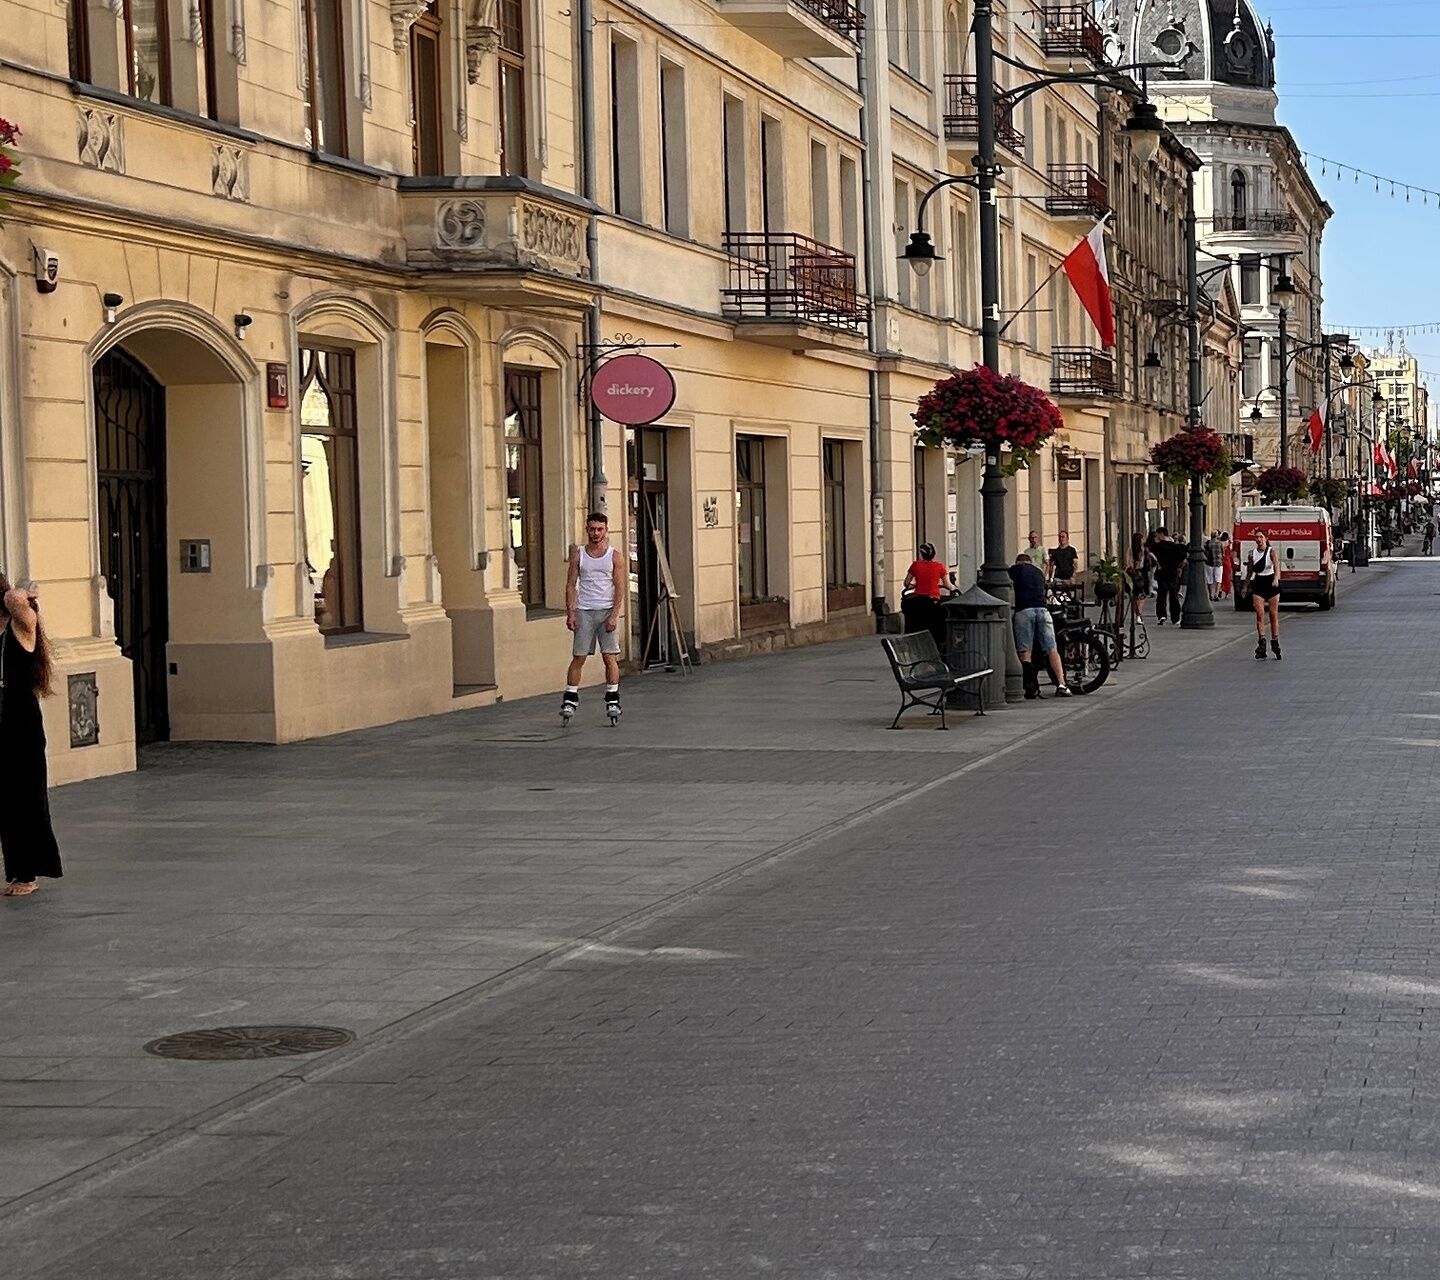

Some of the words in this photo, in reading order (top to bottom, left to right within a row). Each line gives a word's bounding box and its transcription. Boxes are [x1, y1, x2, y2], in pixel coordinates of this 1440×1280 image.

[276, 374, 287, 397] 19
[607, 383, 655, 398] dickery
[1267, 528, 1290, 536] Poczta
[1291, 528, 1313, 536] Polska
